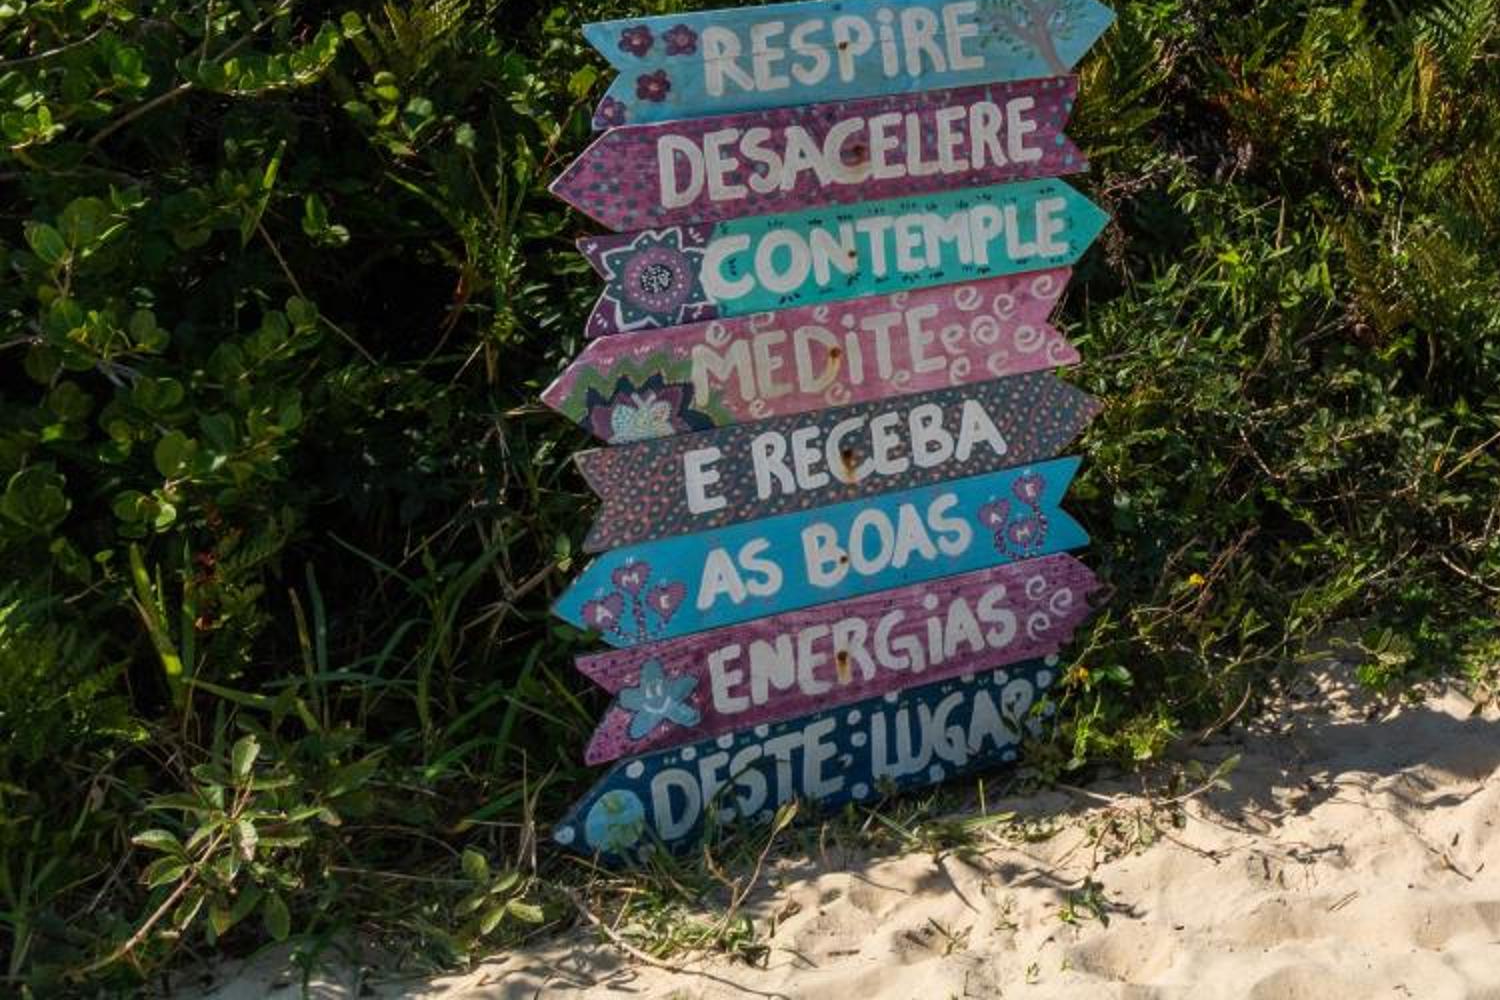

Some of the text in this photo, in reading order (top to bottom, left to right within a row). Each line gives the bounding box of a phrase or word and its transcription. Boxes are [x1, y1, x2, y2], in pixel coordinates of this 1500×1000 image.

[656, 96, 1043, 208] DESACELERE
[700, 198, 1068, 299] CONTEMPLE
[684, 399, 1007, 514] E RECEBA
[697, 493, 972, 610] AS BOAS
[651, 717, 846, 840] DESTE
